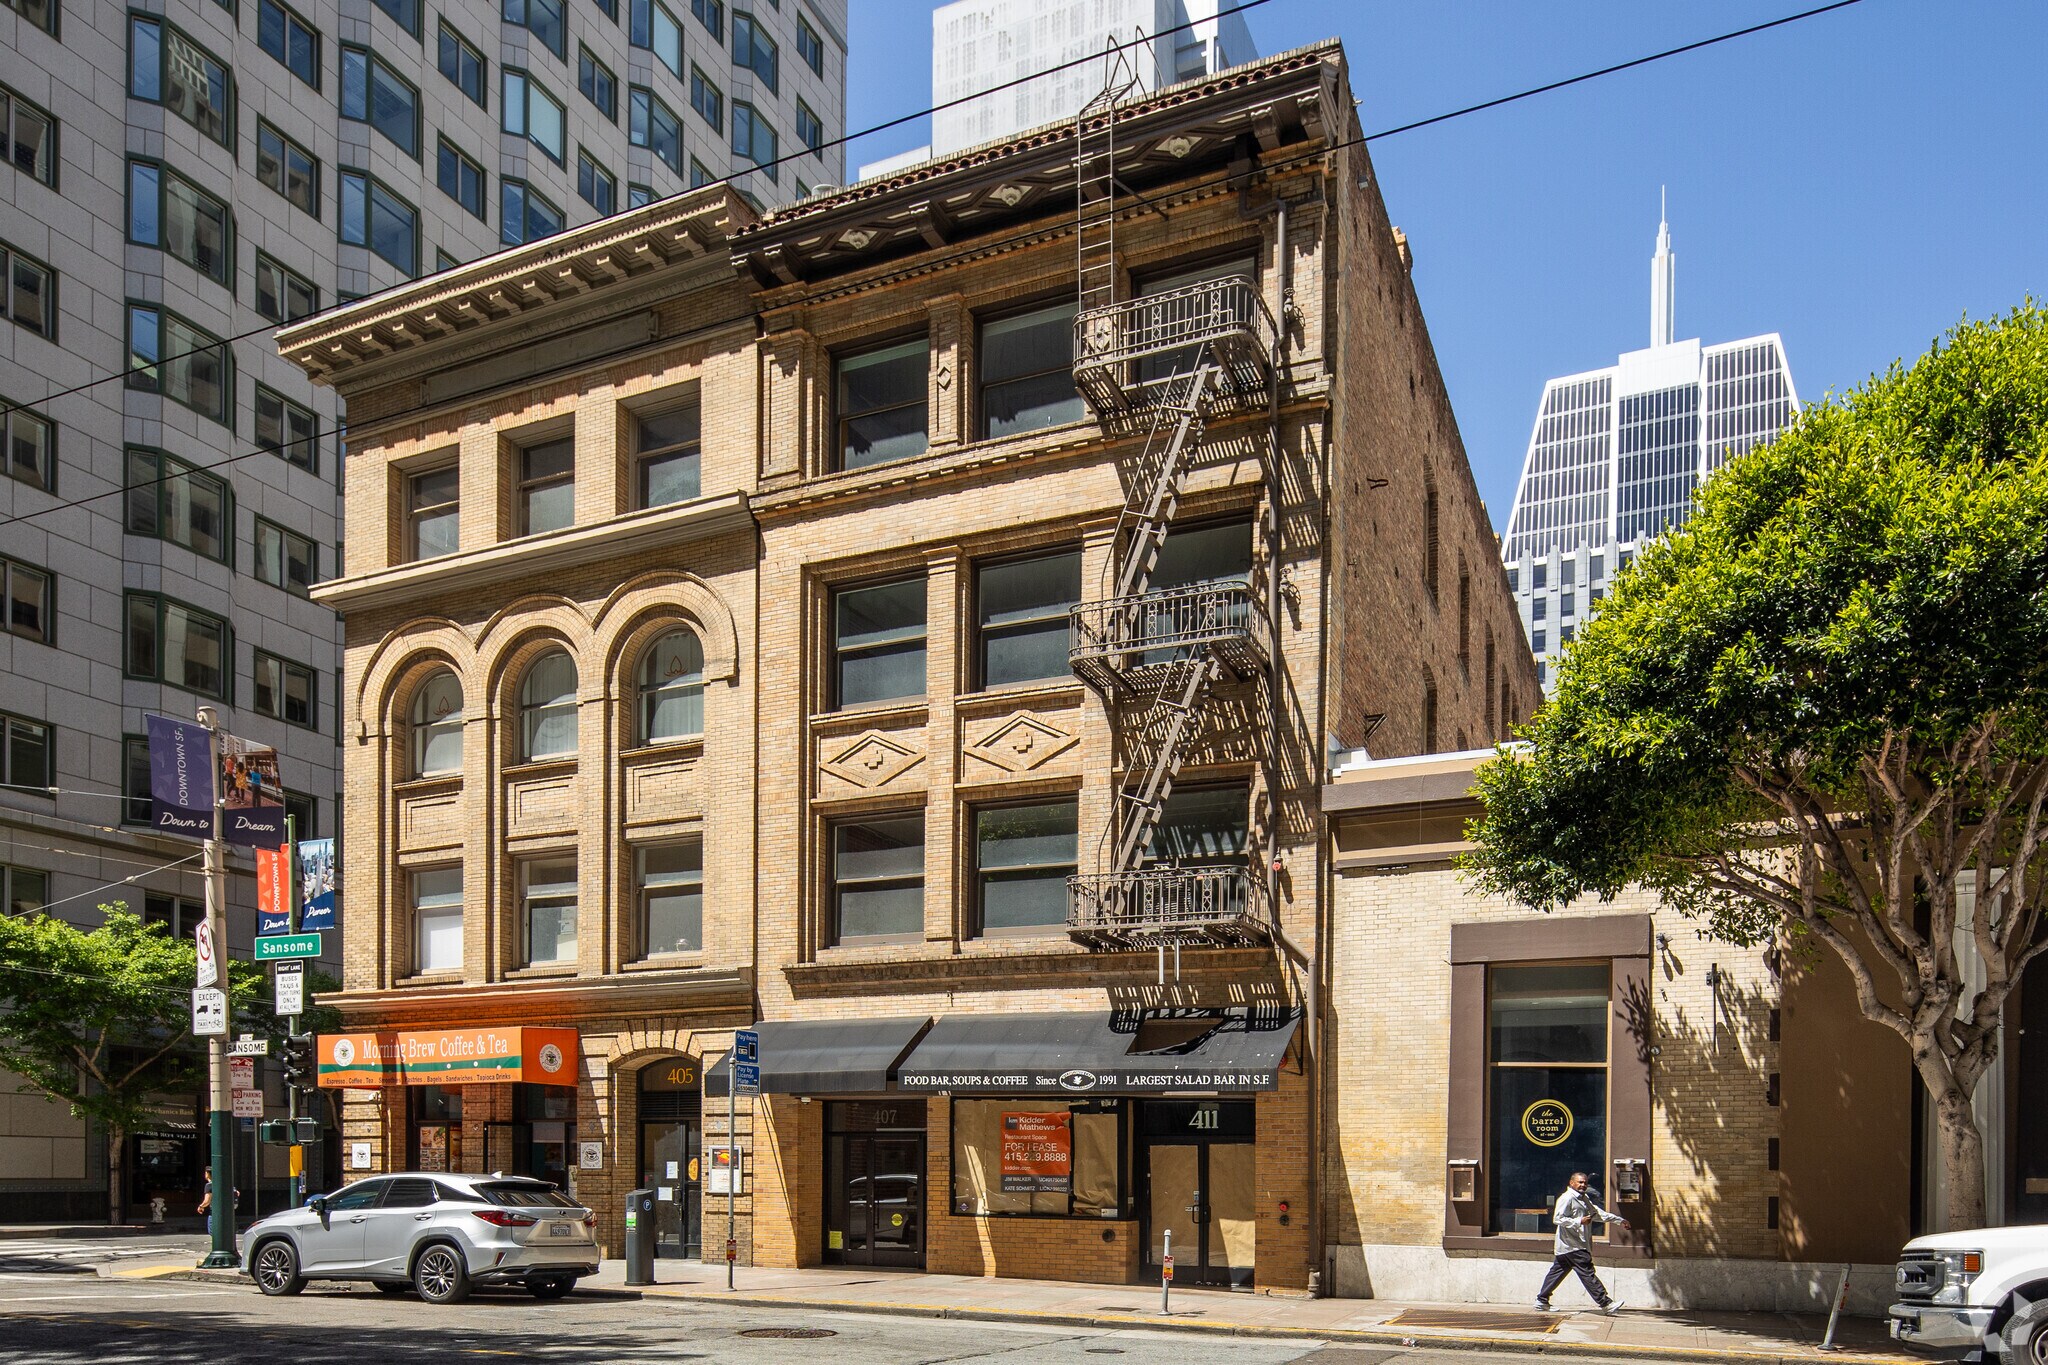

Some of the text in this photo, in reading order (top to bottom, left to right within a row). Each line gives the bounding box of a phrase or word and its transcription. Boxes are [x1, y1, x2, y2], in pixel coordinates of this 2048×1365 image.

[175, 730, 188, 806] DOWNTOWN SF
[160, 812, 209, 831] Down to
[235, 816, 275, 831] Dream
[272, 852, 281, 911] DOWNTOWN SF
[263, 919, 284, 930] Down
[262, 941, 314, 954] Sansome
[198, 993, 220, 1001] EXCEPT
[737, 1033, 746, 1042] Pay
[228, 1043, 266, 1053] SANSOME
[363, 1039, 407, 1063] Morning
[408, 1038, 436, 1059] Brew
[440, 1035, 474, 1058] Coffee
[476, 1035, 486, 1055] &
[488, 1033, 508, 1055] Tea
[326, 1078, 345, 1086] Espresso
[348, 1077, 362, 1085] Coffee
[426, 1075, 442, 1084] Bagels
[445, 1075, 473, 1083] Sandwiches
[477, 1074, 495, 1083] Tapioca
[667, 1068, 694, 1084] 405
[904, 1075, 930, 1086] FOOD
[930, 1075, 952, 1087] BAR,
[952, 1075, 982, 1086] SOUPS
[983, 1075, 991, 1086] &
[992, 1075, 1029, 1086] COFFEE
[1035, 1075, 1057, 1086] Since
[1099, 1075, 1118, 1085] 1991
[1126, 1075, 1174, 1086] LARGEST
[1174, 1075, 1211, 1085] SALAD
[1213, 1074, 1236, 1085] BAR
[1239, 1074, 1250, 1084] IN
[1253, 1074, 1270, 1085] S.F.
[234, 1090, 242, 1098] NO
[872, 1109, 898, 1124] 407
[1189, 1110, 1219, 1128] 411
[1541, 1109, 1554, 1117] the
[1019, 1116, 1046, 1124] Kidder
[1531, 1117, 1564, 1125] barrel
[1004, 1142, 1025, 1151] FOR
[1004, 1152, 1067, 1162] 415.29.8888
